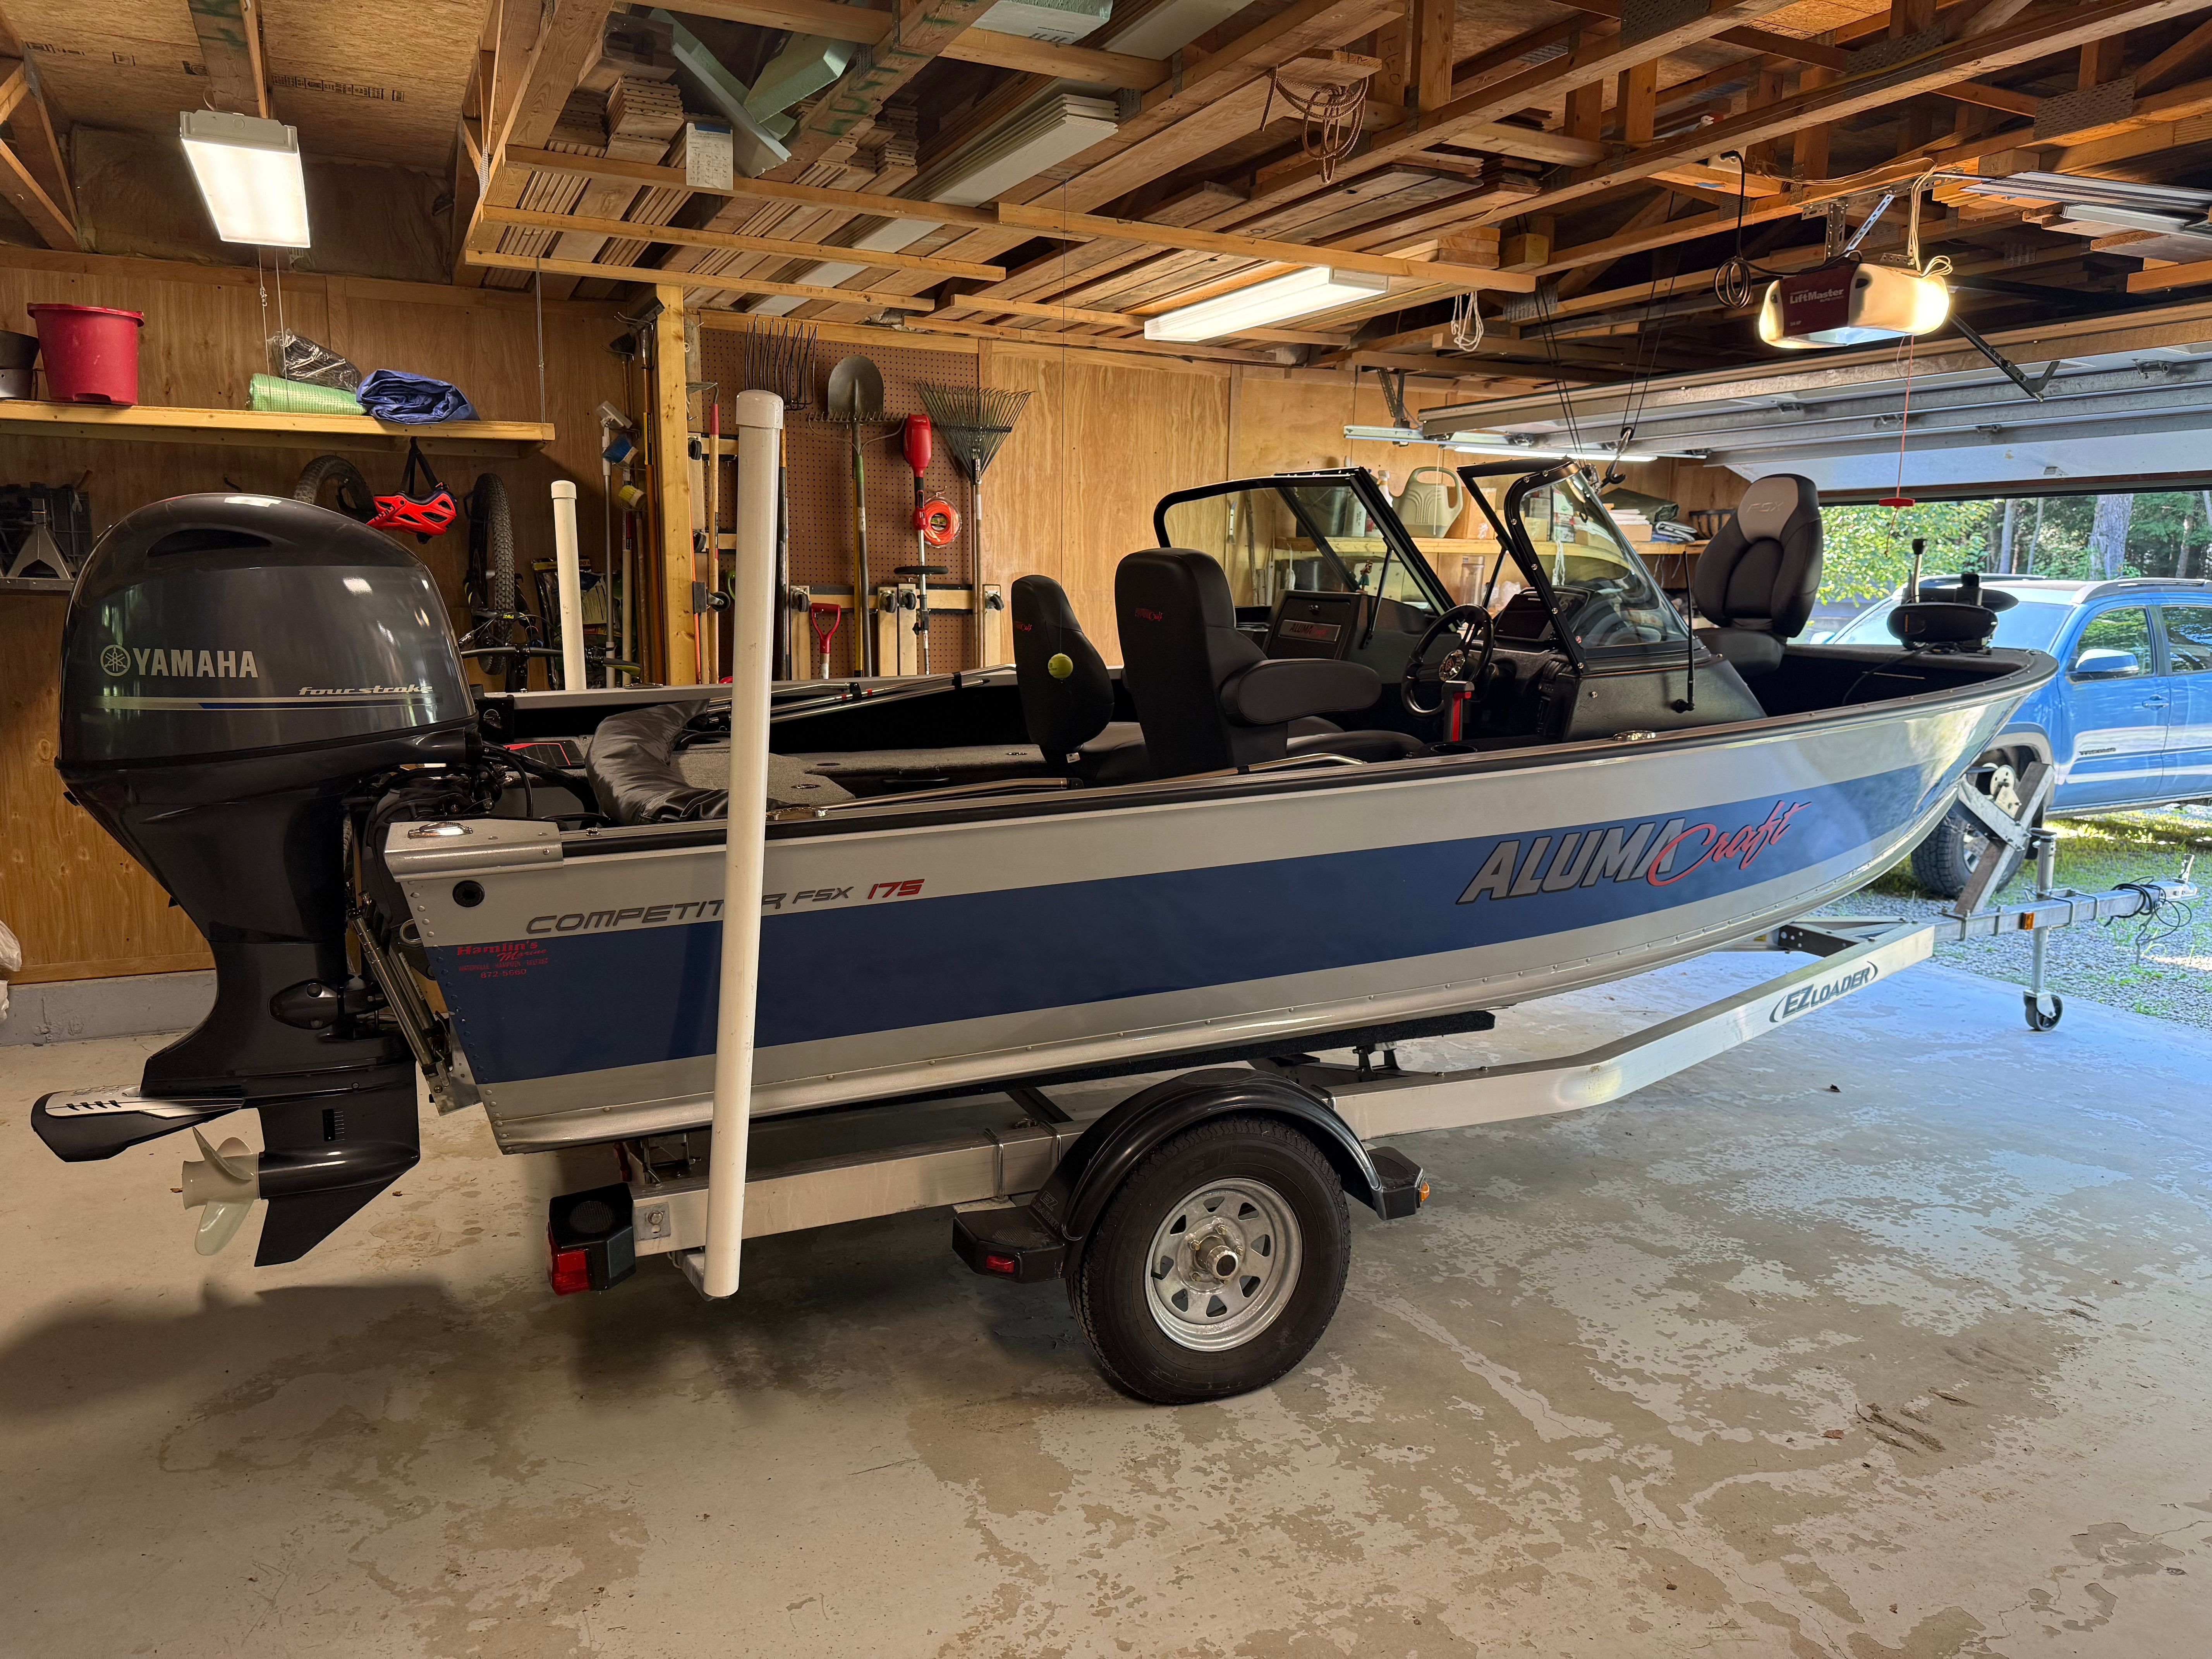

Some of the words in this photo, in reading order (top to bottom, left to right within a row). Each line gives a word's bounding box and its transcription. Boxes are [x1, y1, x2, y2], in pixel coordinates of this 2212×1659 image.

[133, 648, 258, 678] YAMAHA
[526, 893, 787, 934] COMPETITR
[792, 886, 854, 905] FSX
[867, 878, 925, 900] 175
[457, 940, 539, 956] Hamlin's
